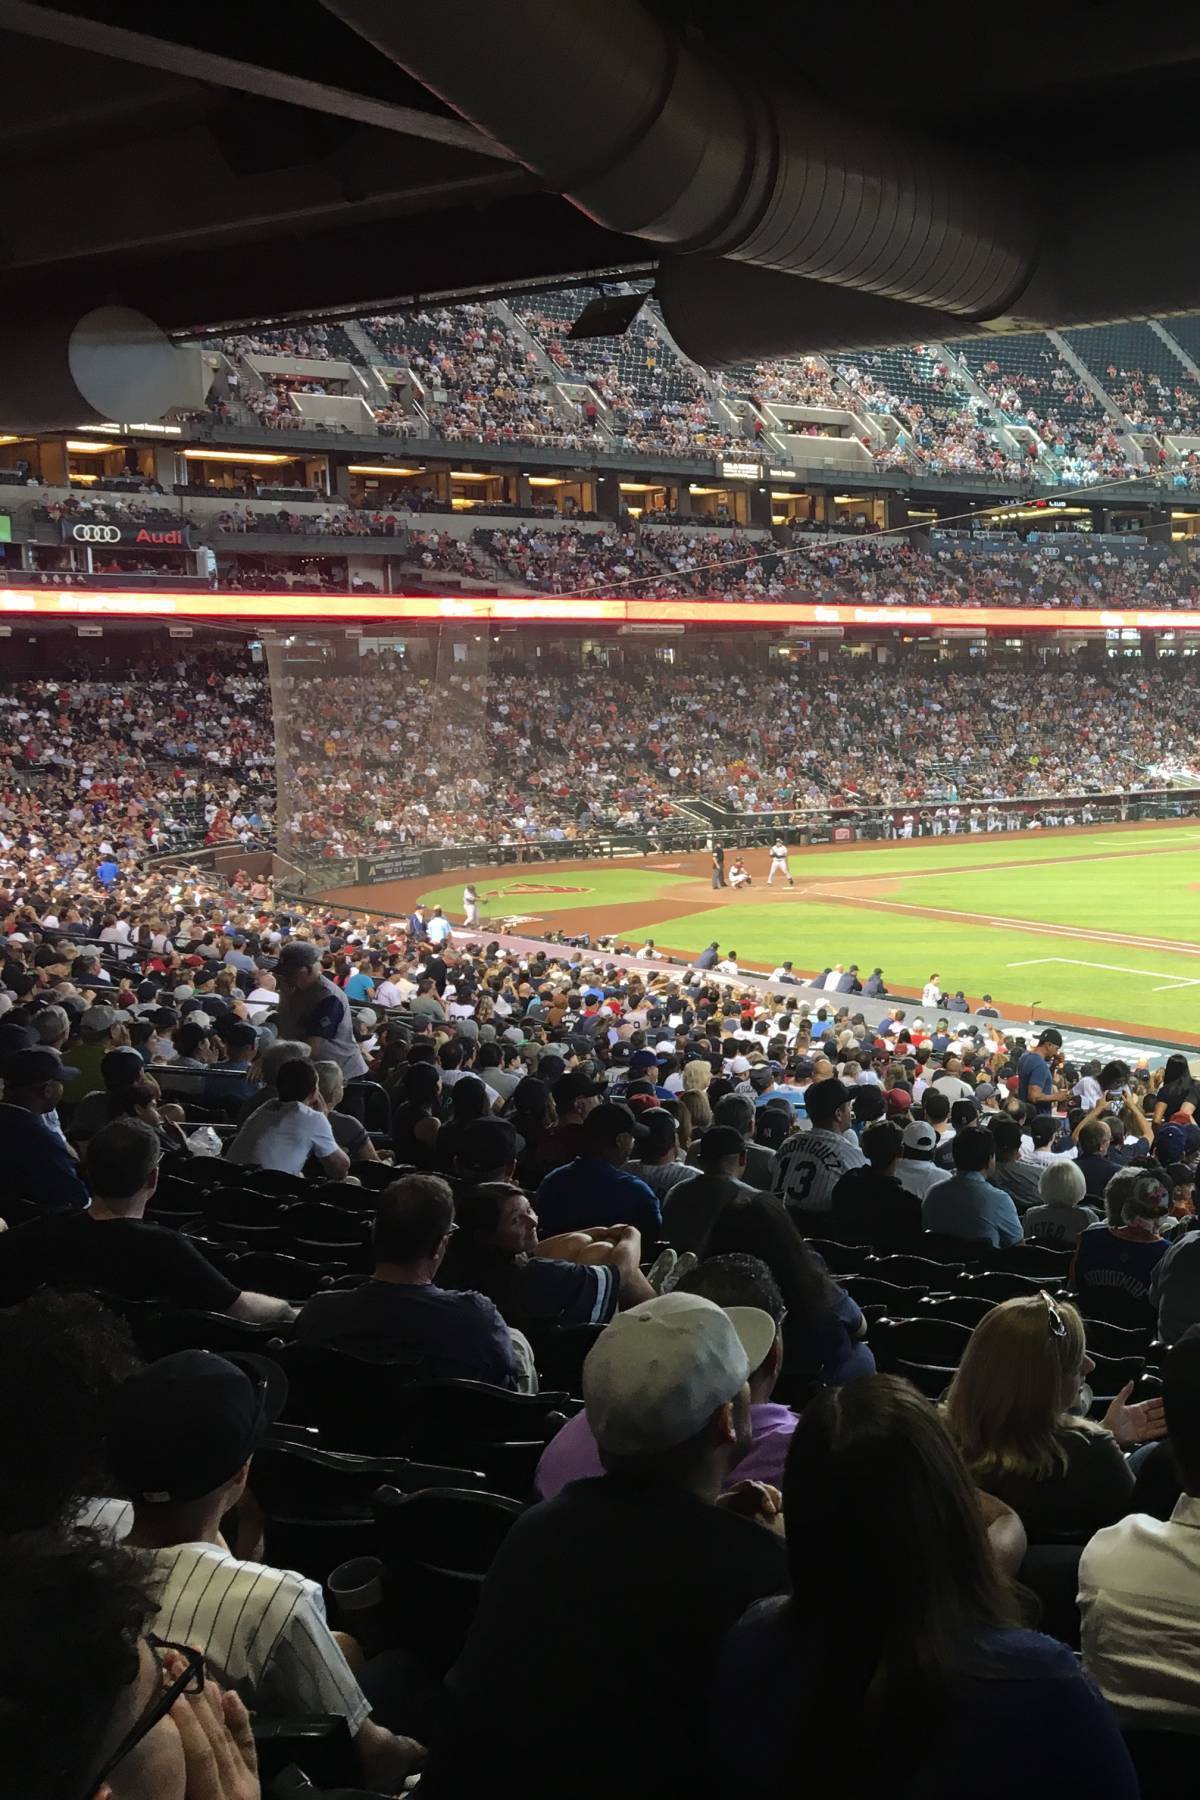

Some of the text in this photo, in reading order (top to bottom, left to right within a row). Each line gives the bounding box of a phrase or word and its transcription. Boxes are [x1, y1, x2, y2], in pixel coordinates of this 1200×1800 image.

[136, 528, 182, 545] Audi
[566, 1023, 574, 1033] 7
[779, 1157, 817, 1200] 13
